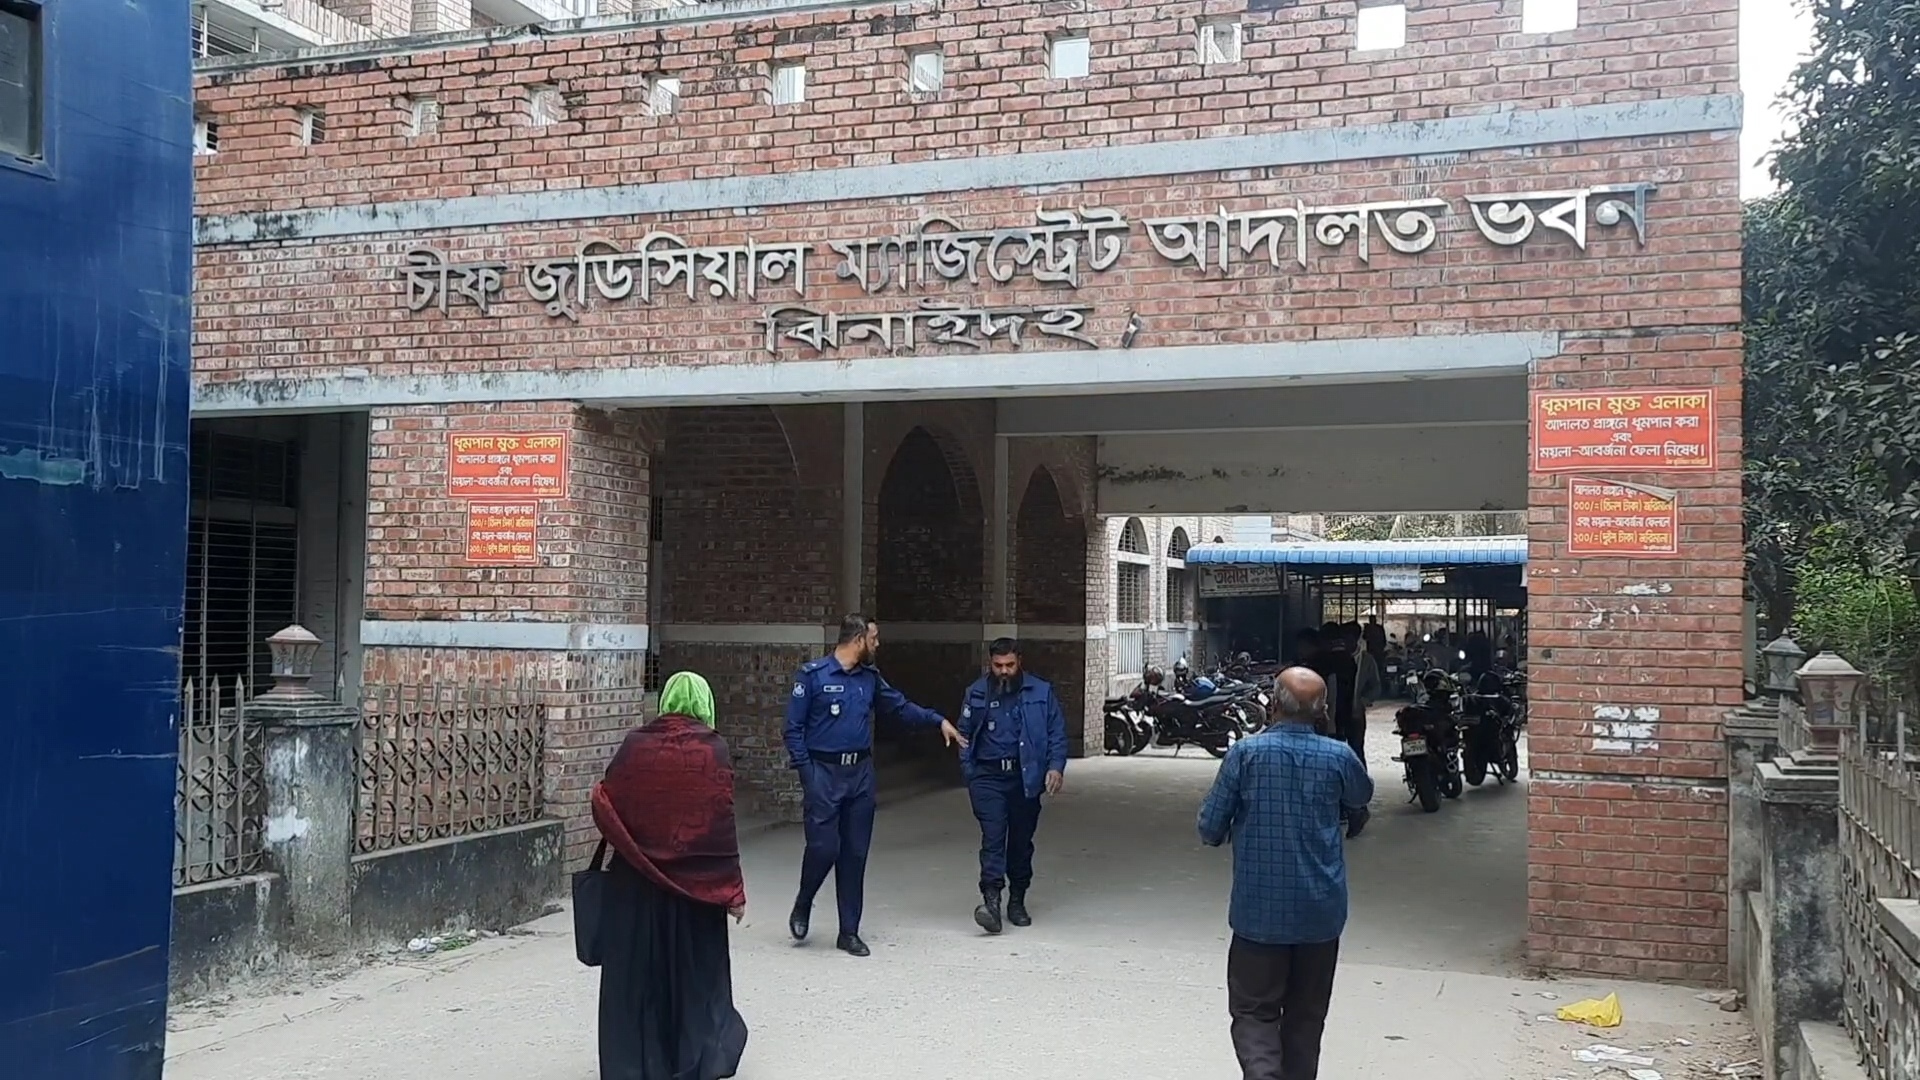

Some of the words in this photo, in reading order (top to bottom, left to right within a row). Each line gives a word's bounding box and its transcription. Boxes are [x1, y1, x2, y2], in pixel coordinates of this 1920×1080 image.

[402, 247, 505, 316] চীফ
[523, 231, 812, 322] জুডিসিয়াল
[827, 204, 1130, 292] ম্যাজিস্ট্রেট
[1141, 198, 1453, 274] আদালত
[1463, 182, 1658, 251] ভবন
[755, 298, 1099, 355] ঝিনাইদহ
[1540, 397, 1602, 416] ধূমপান
[1607, 396, 1644, 415] মুক্ত
[1648, 394, 1708, 410] এলাকা
[1545, 418, 1591, 431] আদালত
[1631, 416, 1672, 431] ধূমপান
[1674, 416, 1700, 428] করা
[454, 437, 494, 452] ধূমপান
[497, 437, 520, 452] মুক্ত
[524, 436, 562, 449] এলাকা
[1610, 432, 1633, 444] এবং
[1629, 444, 1661, 457] ফেলা
